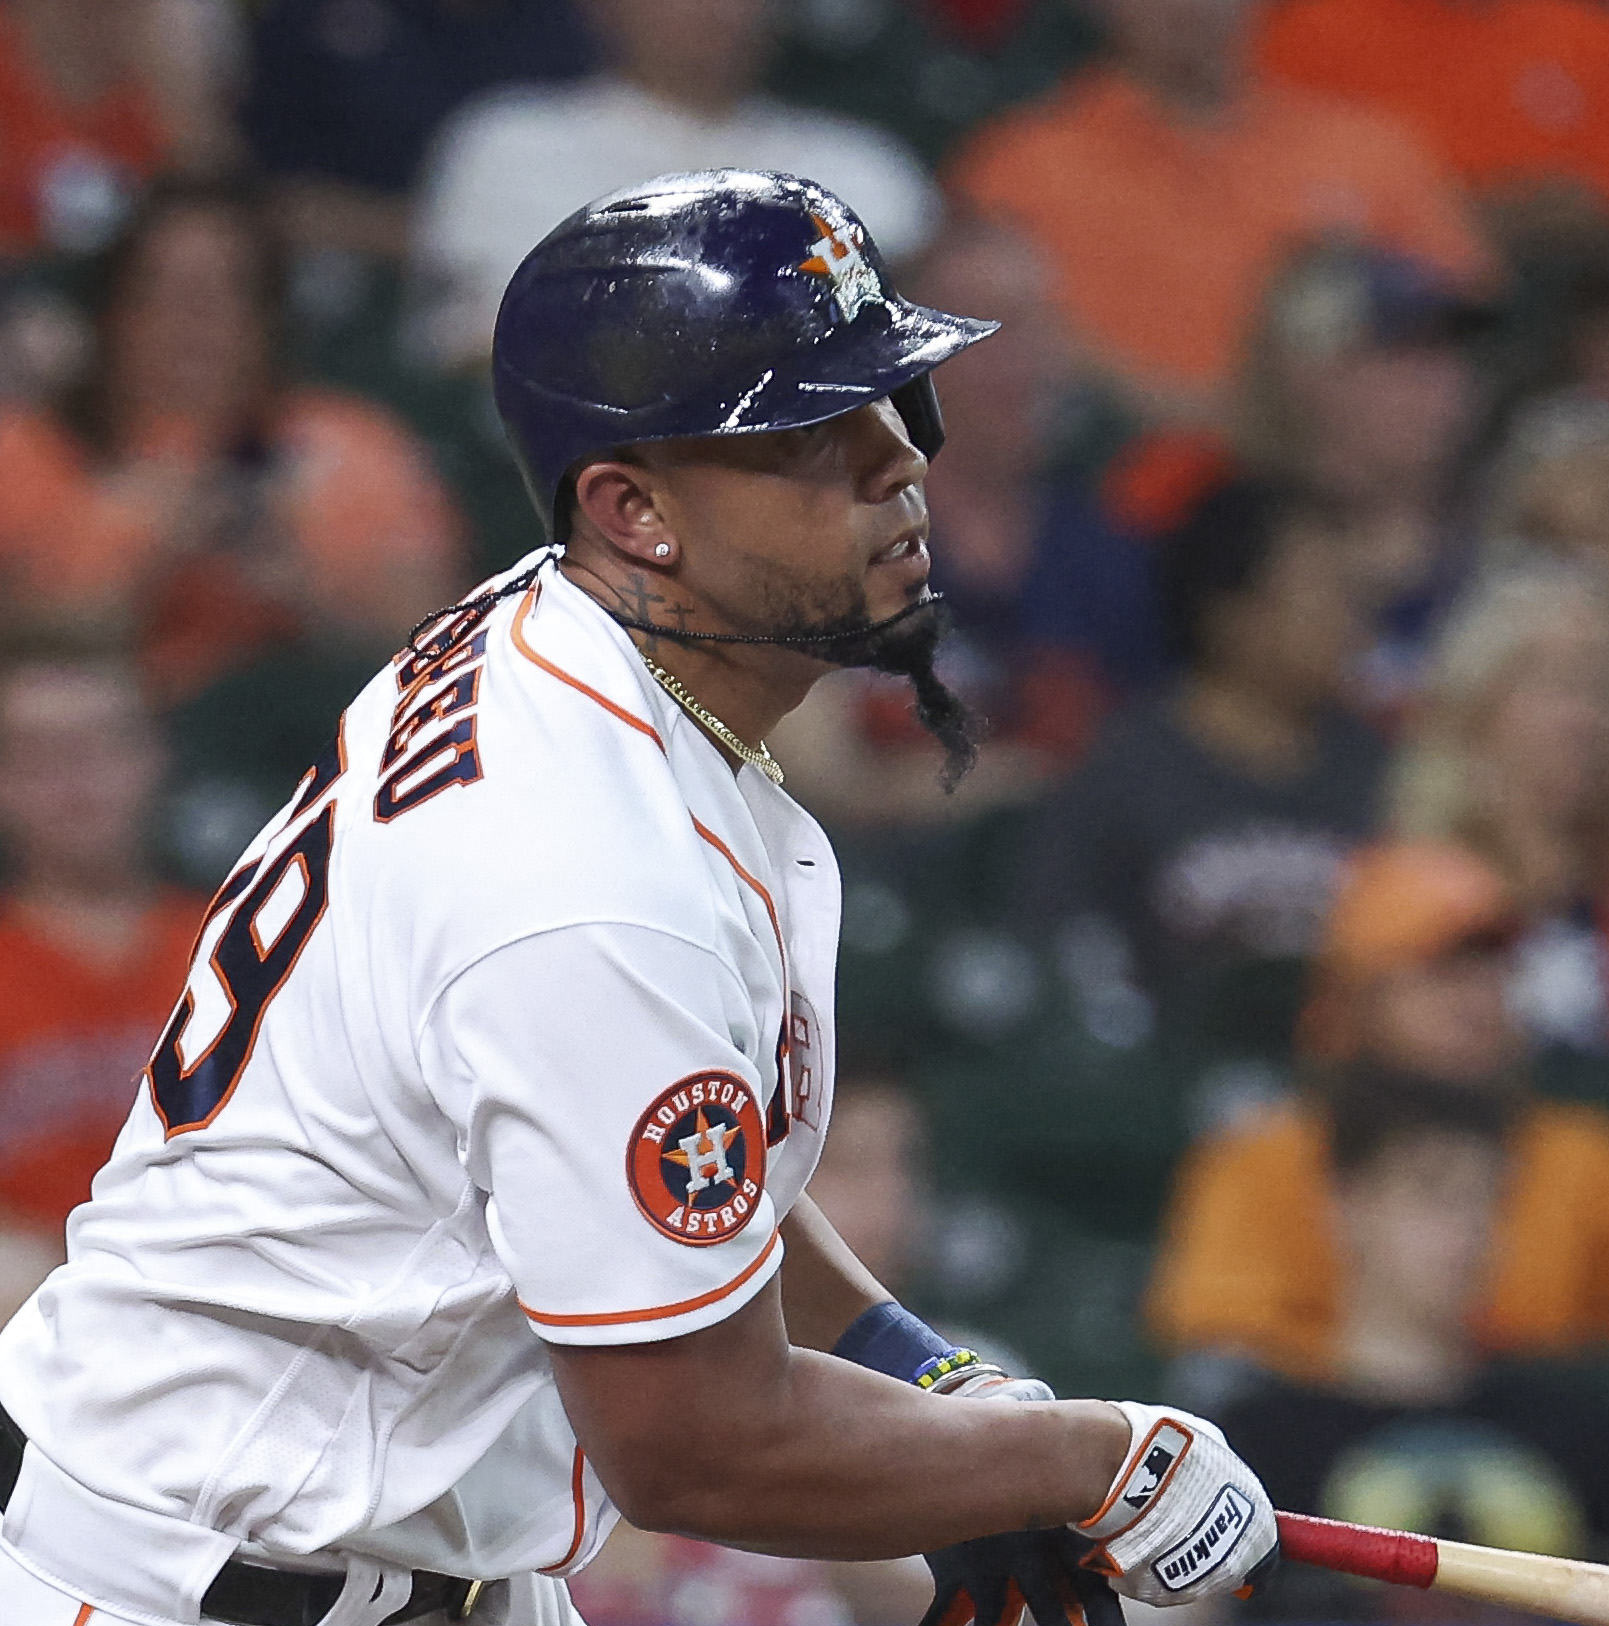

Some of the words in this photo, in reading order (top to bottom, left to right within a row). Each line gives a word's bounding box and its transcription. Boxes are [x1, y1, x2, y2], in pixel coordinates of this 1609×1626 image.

[642, 1080, 748, 1144] HOUSTON
[678, 1122, 734, 1195] H
[665, 1177, 758, 1233] ASTROS
